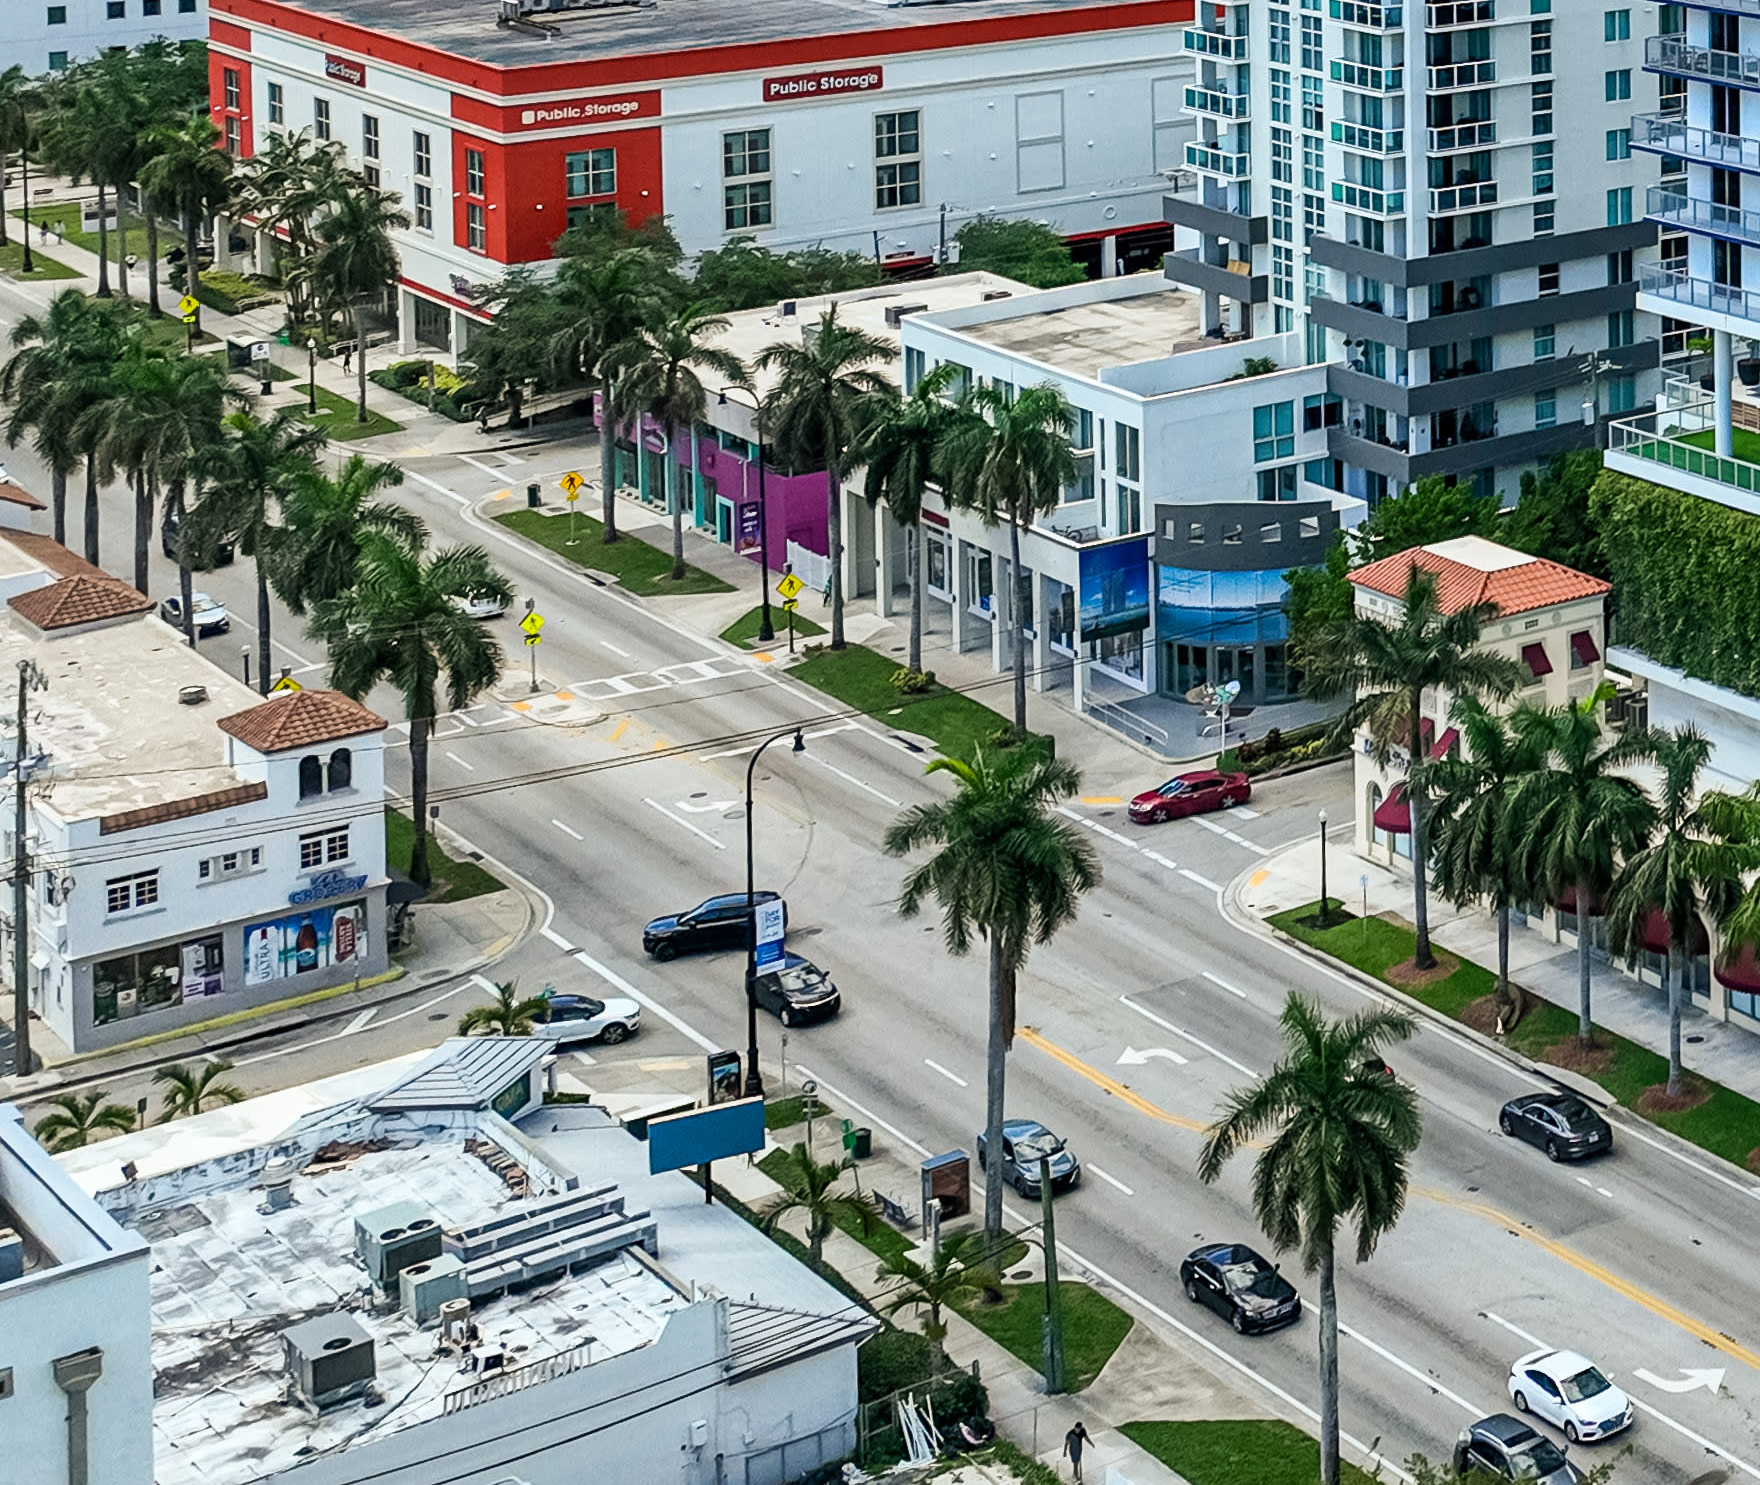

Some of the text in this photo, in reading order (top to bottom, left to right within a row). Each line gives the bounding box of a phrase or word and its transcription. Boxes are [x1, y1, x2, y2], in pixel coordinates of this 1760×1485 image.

[770, 73, 879, 96] Public Storage
[536, 101, 639, 121] Public Storage
[260, 942, 271, 980] ULTRA
